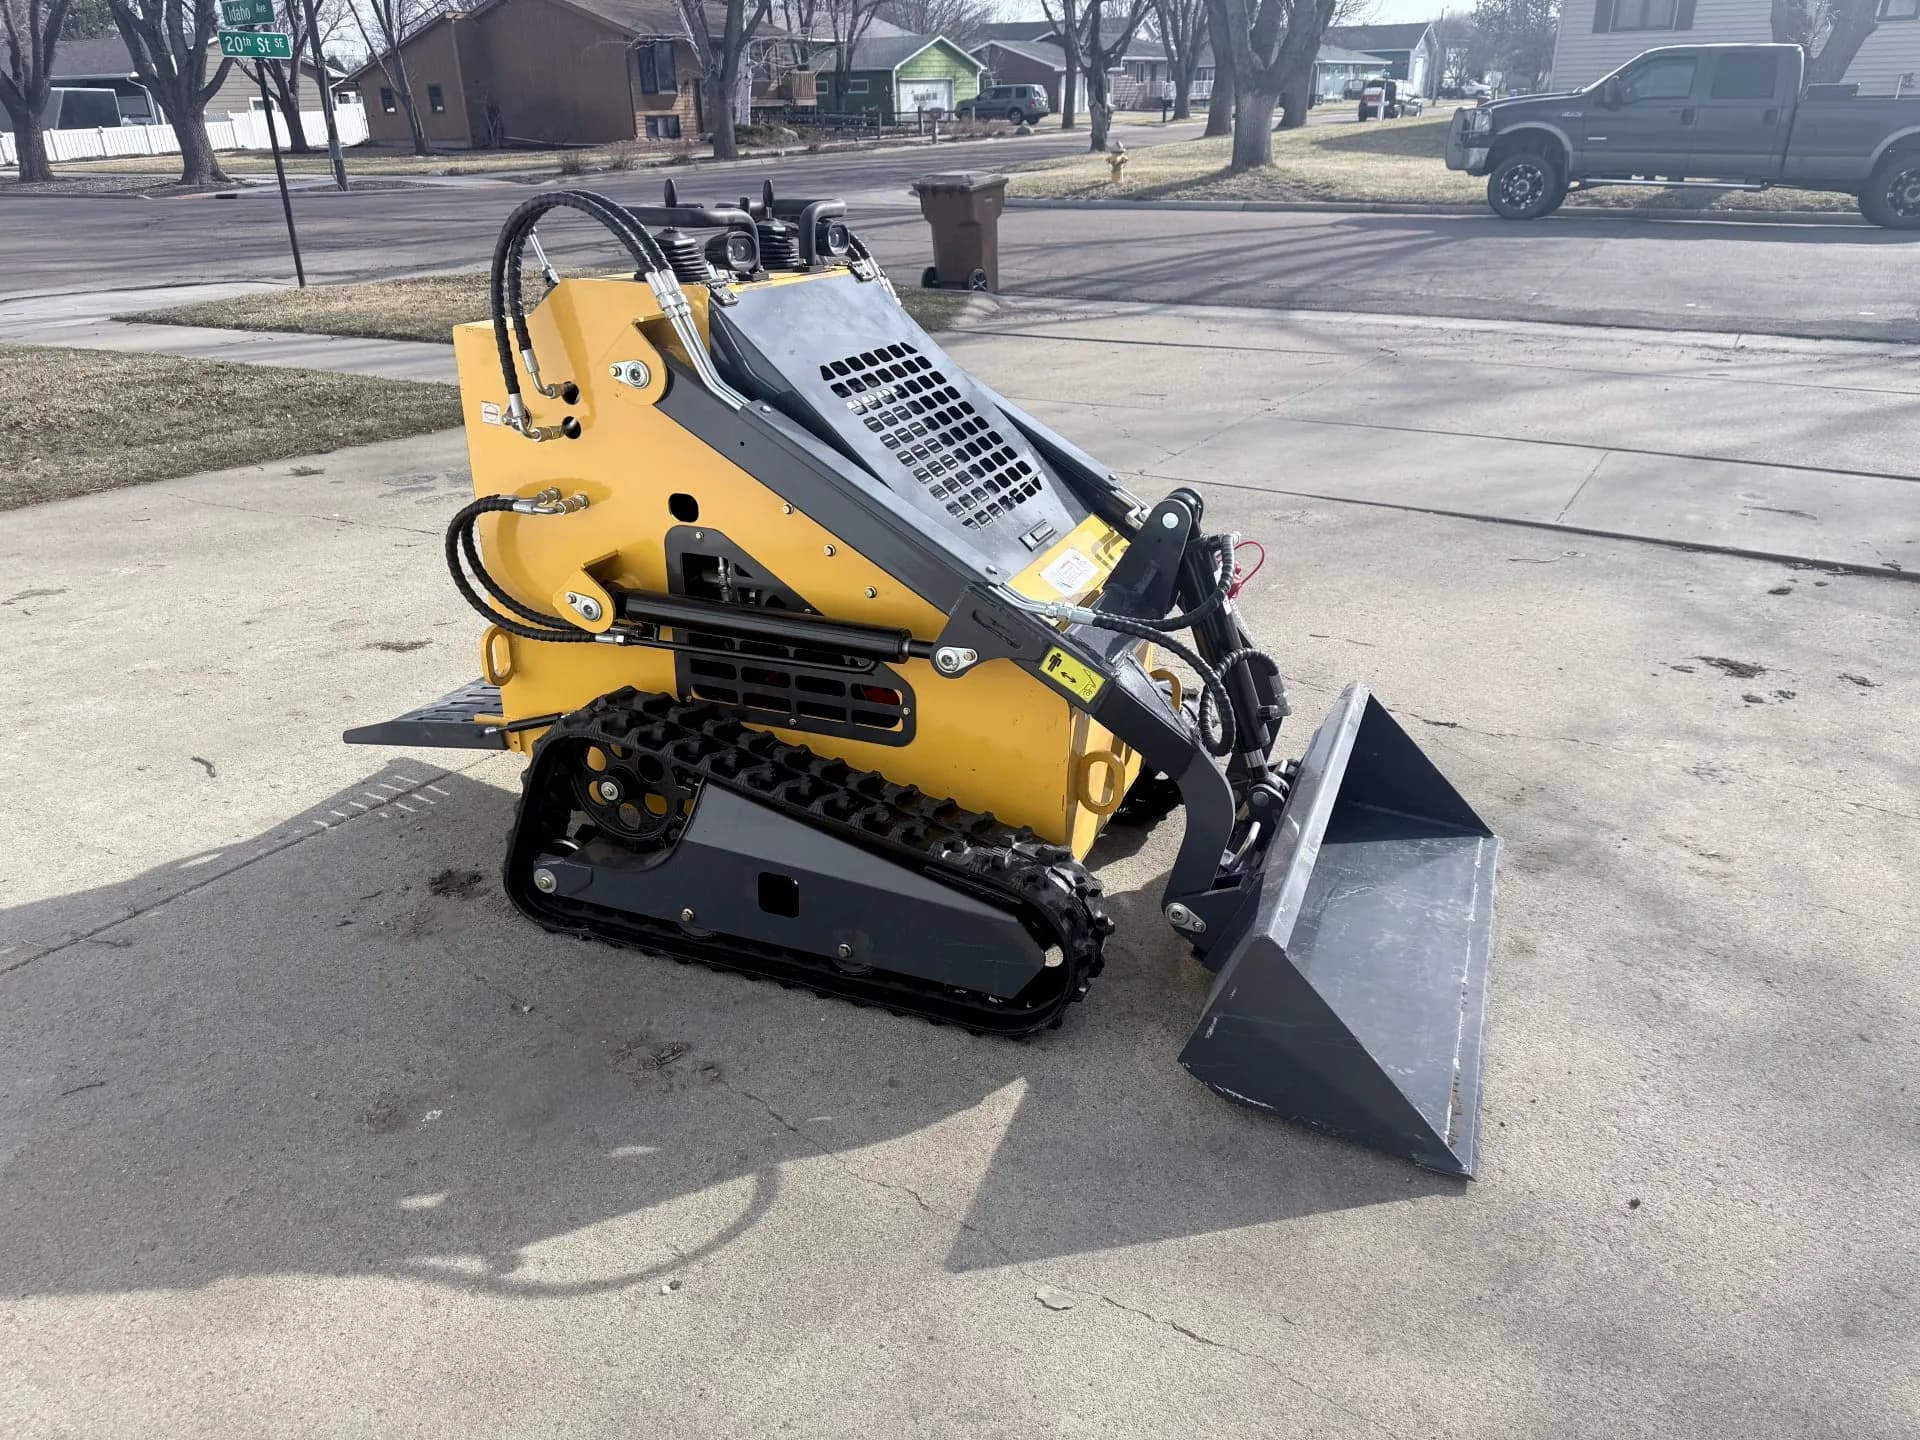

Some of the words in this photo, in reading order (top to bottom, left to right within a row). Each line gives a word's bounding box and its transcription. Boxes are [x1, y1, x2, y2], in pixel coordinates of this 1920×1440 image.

[227, 5, 251, 22] Idaho
[255, 3, 267, 13] Ave
[225, 35, 252, 53] 20th
[256, 37, 271, 53] St
[274, 38, 285, 48] SE
